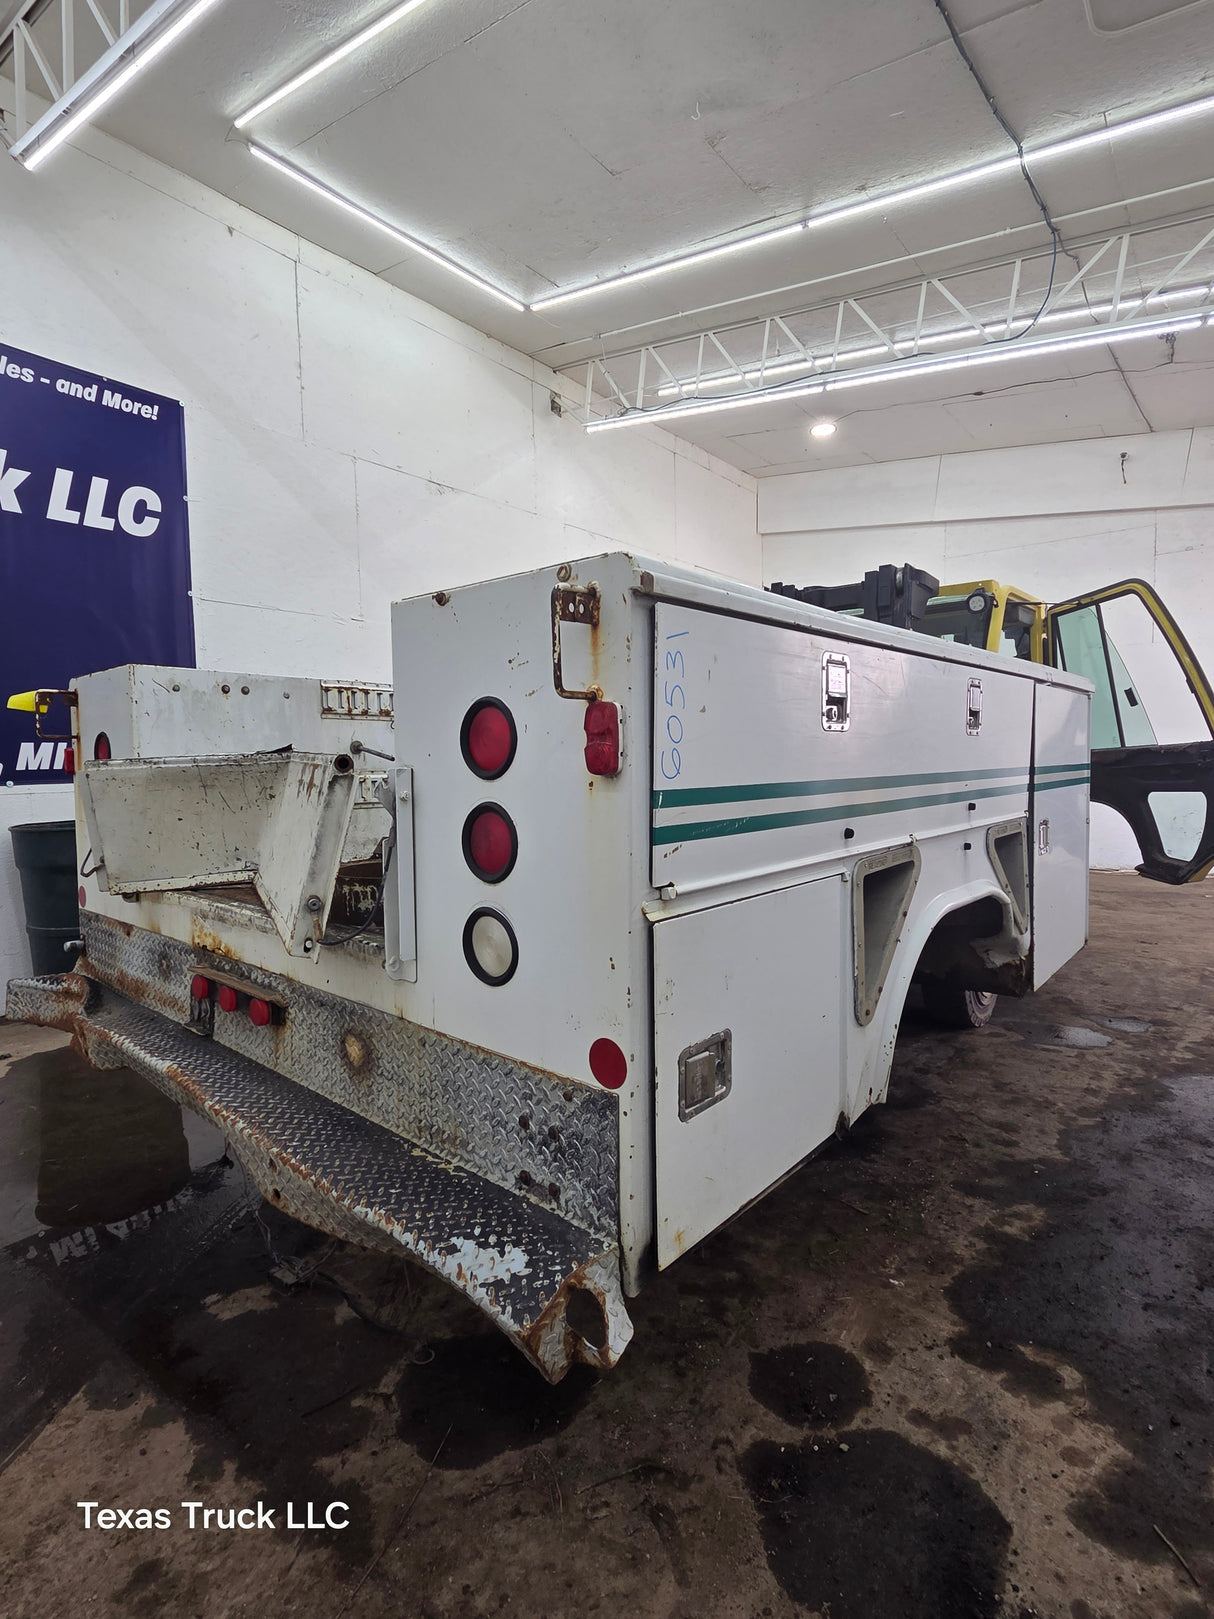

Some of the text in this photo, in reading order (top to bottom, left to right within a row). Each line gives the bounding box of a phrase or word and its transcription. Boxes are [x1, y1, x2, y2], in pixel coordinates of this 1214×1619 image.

[55, 378, 98, 402] and
[101, 389, 159, 420] More!
[46, 467, 162, 538] LLC
[661, 631, 690, 780] 60531
